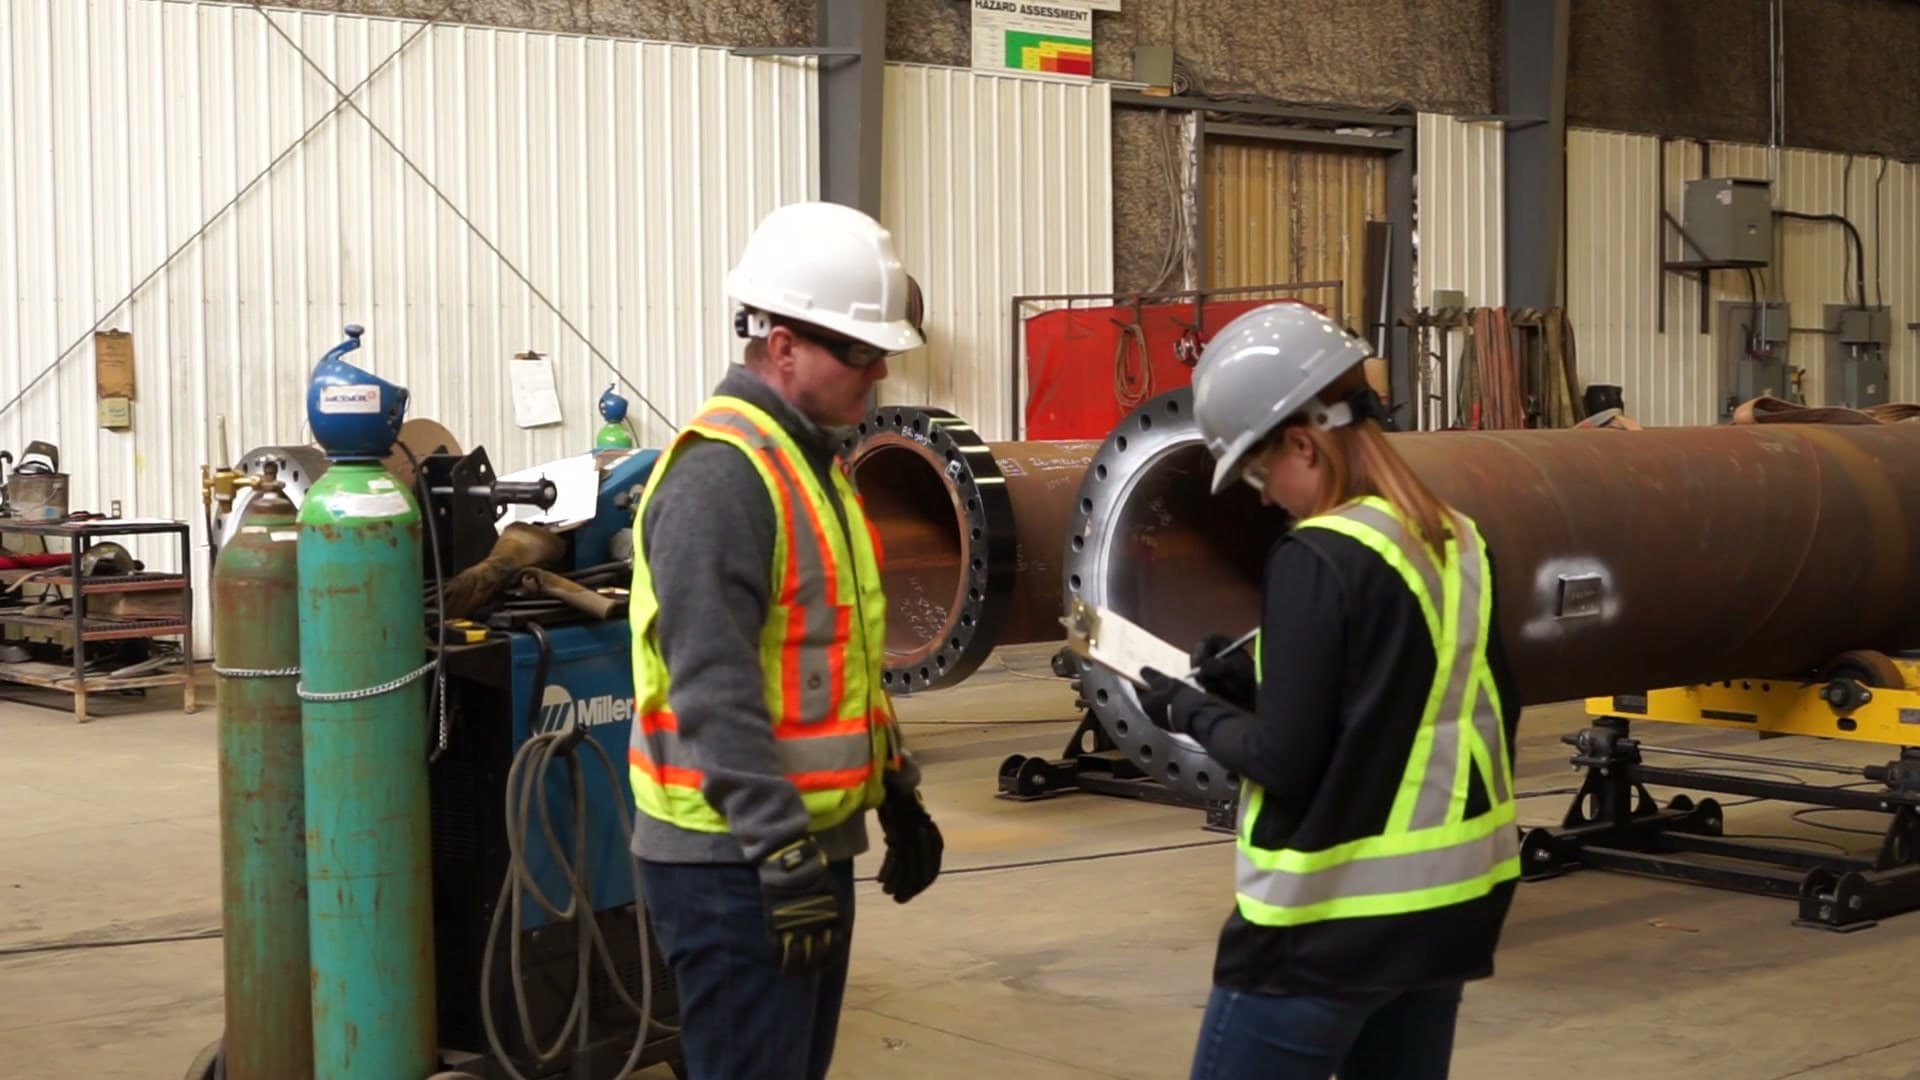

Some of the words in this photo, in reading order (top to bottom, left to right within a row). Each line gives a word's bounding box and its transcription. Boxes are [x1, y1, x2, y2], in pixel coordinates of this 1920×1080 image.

[975, 0, 1016, 13] HAZARD
[1020, 4, 1088, 21] ASSESSMENT
[577, 694, 633, 726] Miller
